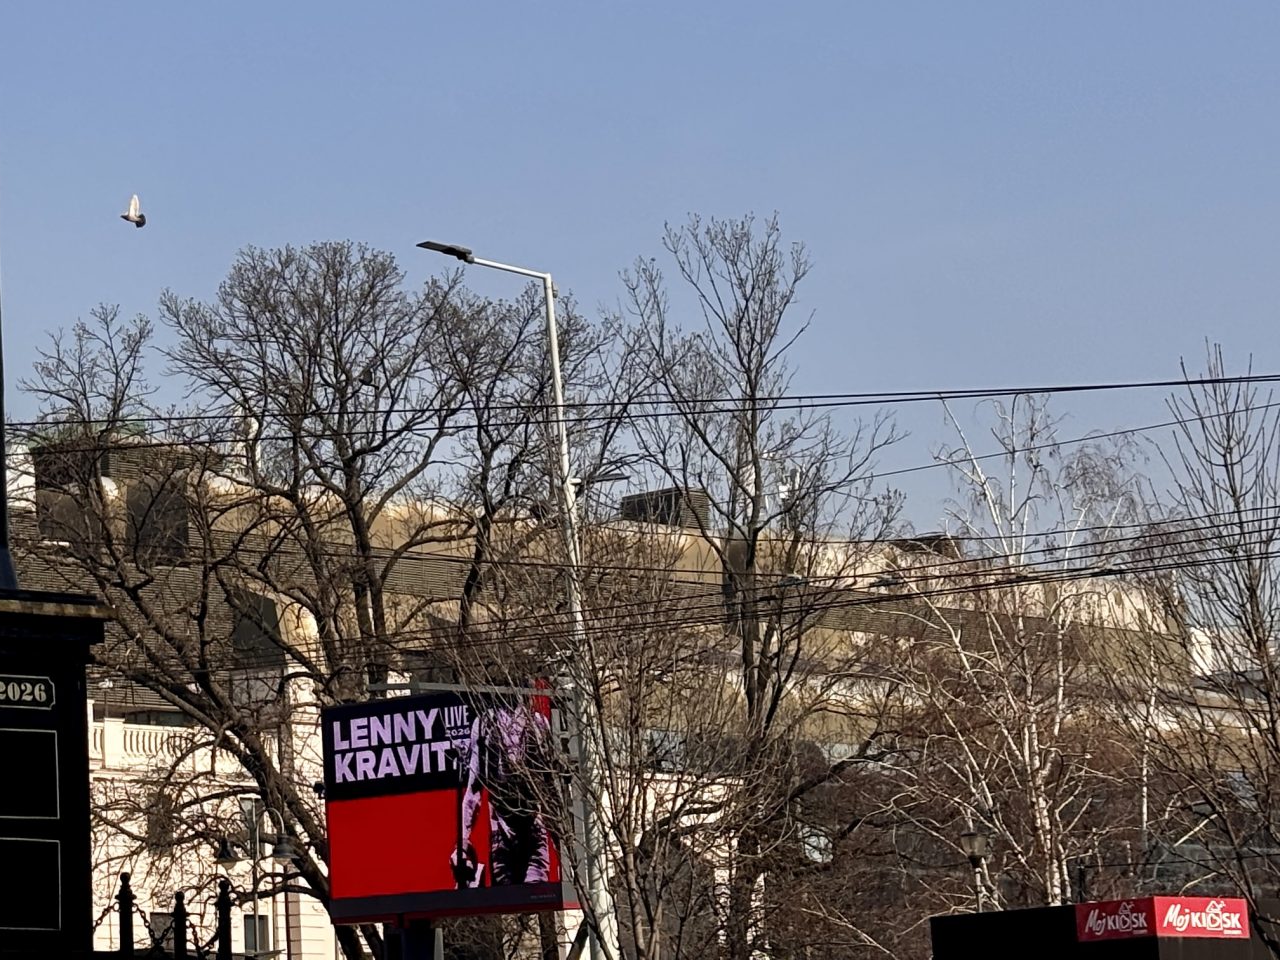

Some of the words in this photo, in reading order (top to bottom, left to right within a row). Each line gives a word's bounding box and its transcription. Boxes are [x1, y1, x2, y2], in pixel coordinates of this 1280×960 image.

[444, 704, 470, 728] LIVE
[333, 707, 439, 751] LENNY
[445, 727, 471, 737] 2026
